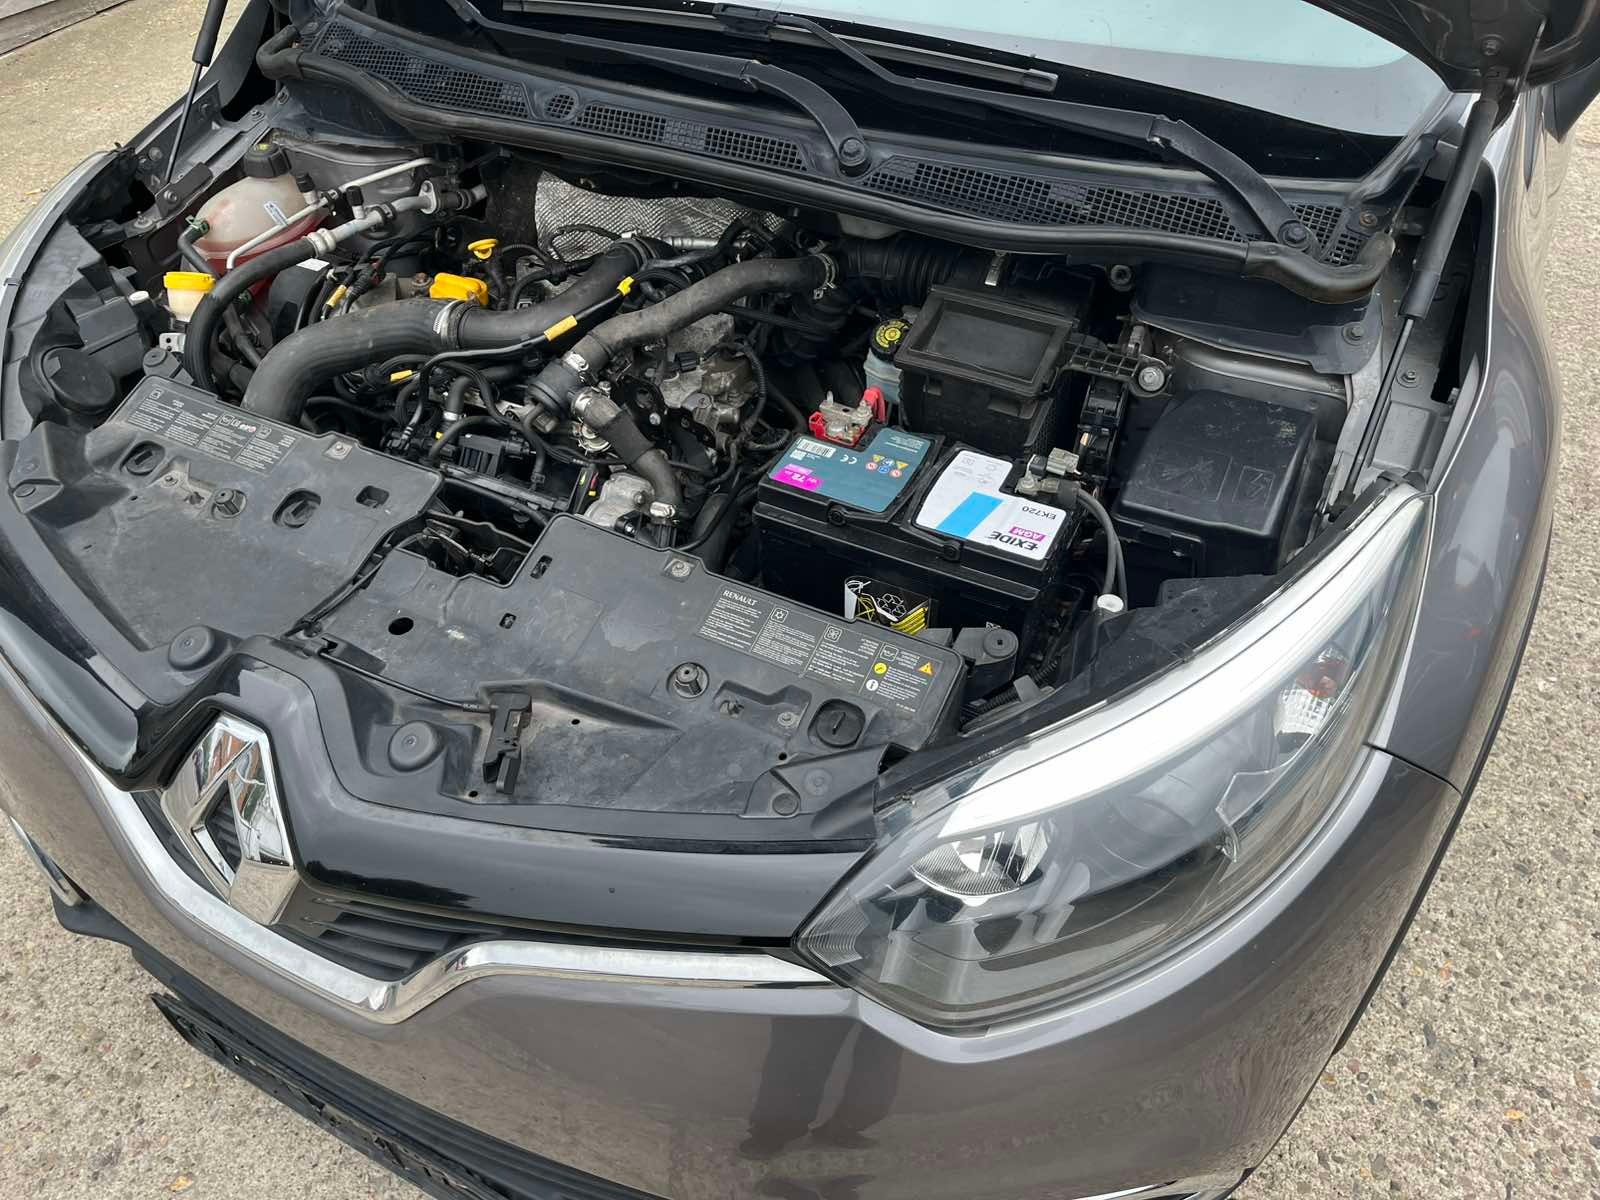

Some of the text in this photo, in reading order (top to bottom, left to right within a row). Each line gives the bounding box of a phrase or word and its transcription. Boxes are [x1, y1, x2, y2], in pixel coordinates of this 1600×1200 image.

[1022, 505, 1057, 520] EK720
[988, 531, 1038, 551] EXIDE
[1014, 527, 1042, 540] AGM
[723, 590, 758, 606] RENAULT
